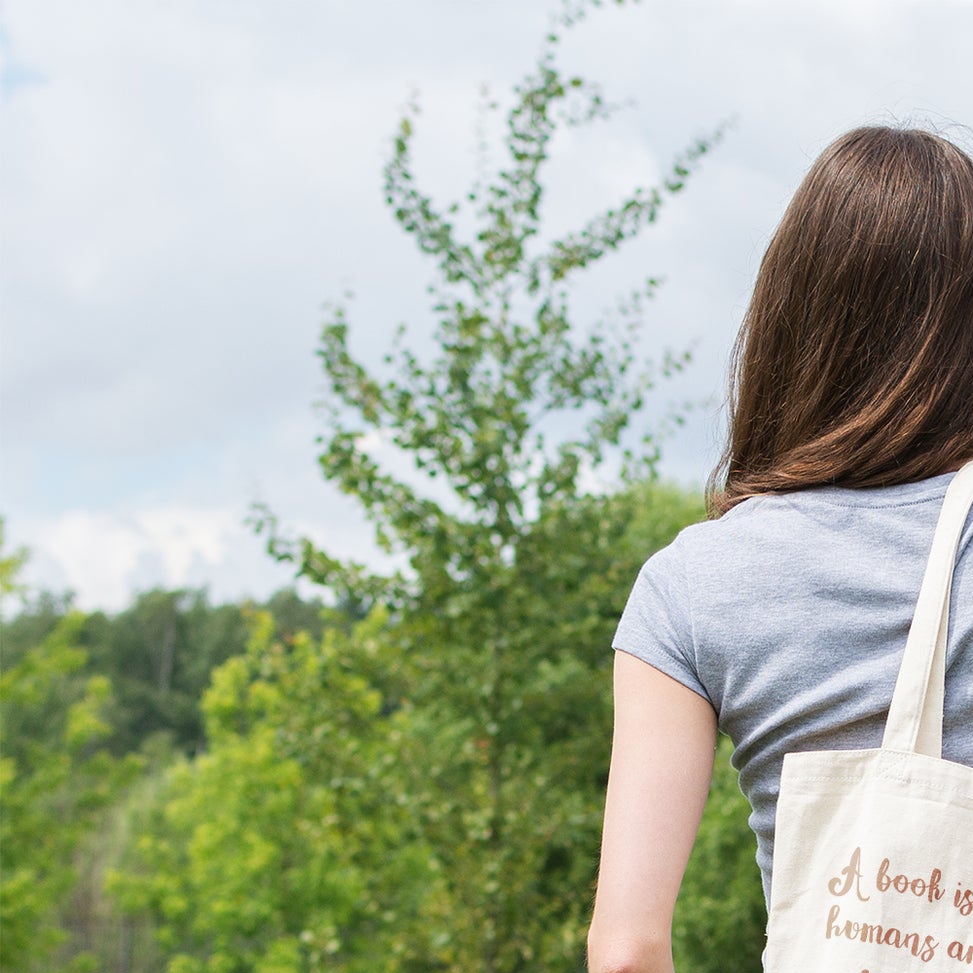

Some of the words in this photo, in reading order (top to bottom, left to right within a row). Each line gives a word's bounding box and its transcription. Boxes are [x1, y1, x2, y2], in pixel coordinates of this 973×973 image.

[828, 847, 870, 902] A
[876, 858, 945, 903] book
[825, 904, 940, 962] humans
